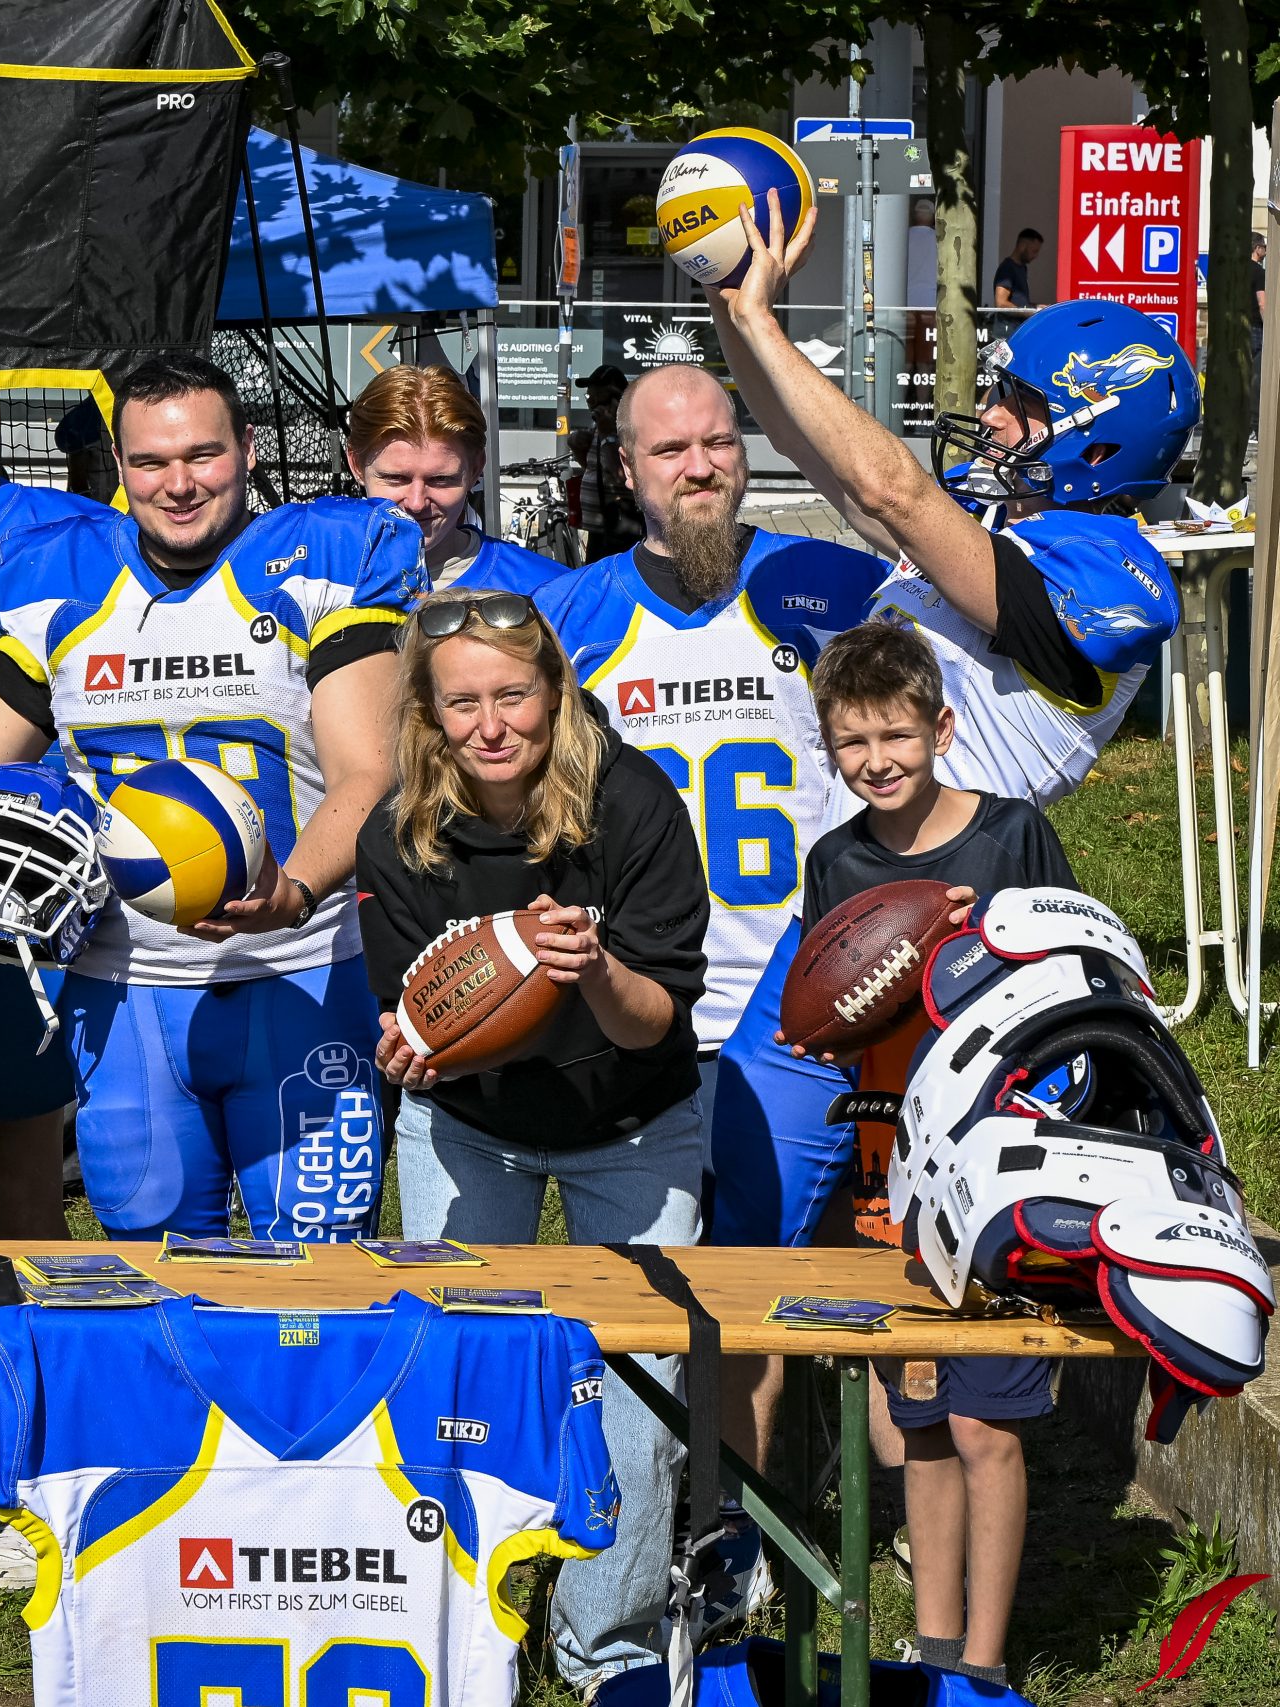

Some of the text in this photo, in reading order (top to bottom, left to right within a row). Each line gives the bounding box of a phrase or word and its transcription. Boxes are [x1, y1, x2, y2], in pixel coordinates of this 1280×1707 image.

[156, 93, 195, 110] PRO
[1081, 142, 1183, 172] REWE
[670, 163, 709, 181] Champ
[1080, 192, 1180, 217] Einfahrt
[1149, 231, 1174, 268] P
[1127, 293, 1178, 304] Parkhaus
[624, 315, 652, 323] VITAL
[498, 344, 583, 353] KS AUDITING GH
[268, 547, 306, 574] TND
[785, 597, 826, 612] TNKD
[251, 620, 273, 638] 43
[129, 654, 255, 682] TIEBEL
[774, 651, 795, 667] 43
[85, 684, 260, 705] VOM FIRST BIS ZUM GIEBEL
[658, 677, 774, 706] TIEBEL
[624, 708, 775, 728] VOM FIRST BIS ZUM GIEBEL
[236, 807, 256, 845] APPROVED
[1031, 903, 1120, 930] CHAMPRO
[412, 940, 488, 1014] SPALDING
[425, 960, 497, 1029] ADVANCE
[319, 1048, 348, 1084] DE
[297, 1111, 334, 1193] GEHT
[281, 1331, 302, 1344] 2XL
[409, 1508, 438, 1533] 43
[239, 1547, 407, 1584] TIEBEL
[181, 1592, 408, 1613] VOM FIRST BIS ZUM GIEBEL
